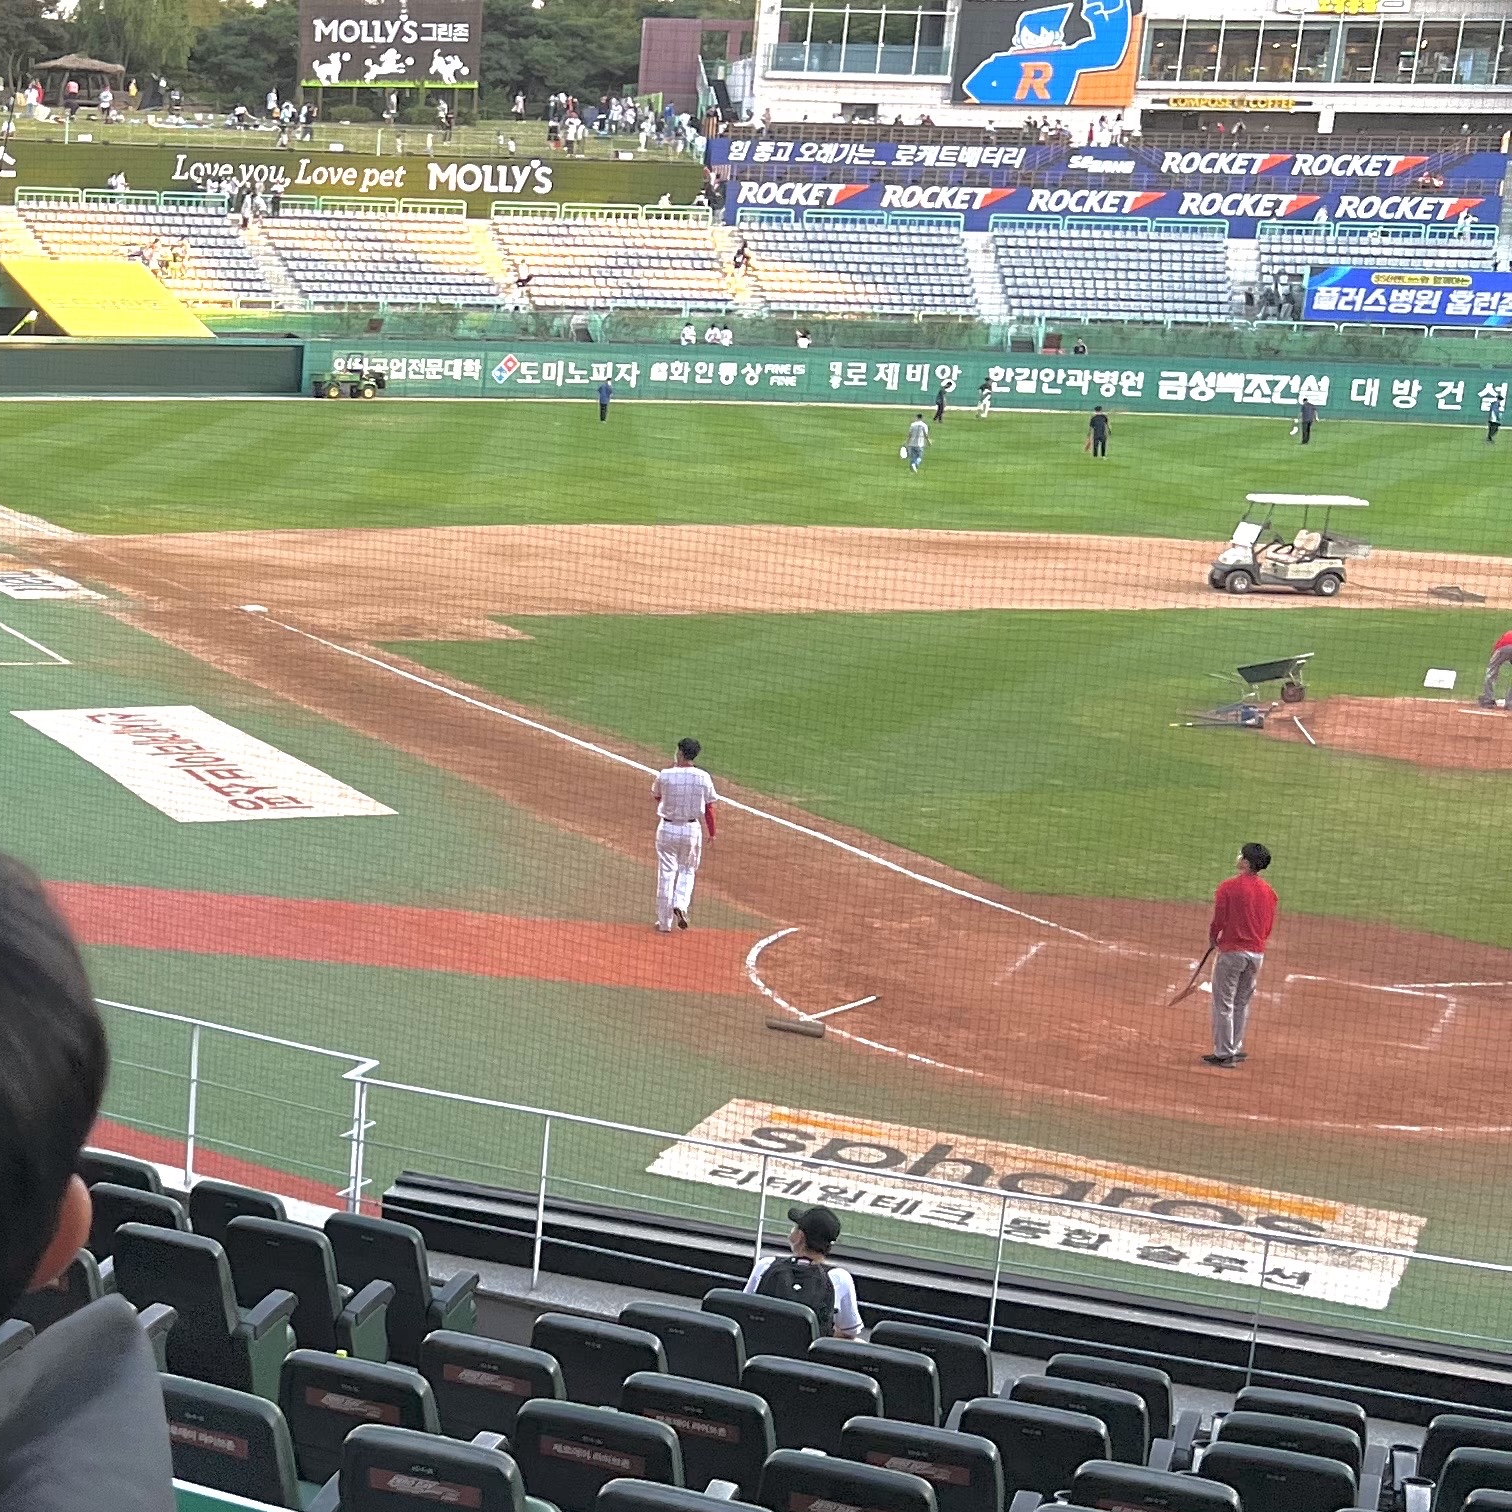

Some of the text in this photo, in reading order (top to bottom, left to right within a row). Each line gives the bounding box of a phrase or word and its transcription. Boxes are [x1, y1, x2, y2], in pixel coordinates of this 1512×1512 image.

[312, 14, 470, 44] MOLLY'S 그린존
[1169, 95, 1296, 111] COMPOSE COFFEE
[728, 140, 751, 161] 힘
[752, 141, 794, 163] 좋고
[891, 144, 1027, 169] 로케트배터리
[1160, 151, 1406, 177] ROCKET ROCKET
[172, 154, 407, 193] Love you, Love pet
[427, 159, 553, 195] MOLLY'S
[738, 181, 1459, 221] ROCKET ROCKET ROCKET ROCKET ROCKET
[1312, 286, 1443, 314] 플러스병원
[516, 360, 641, 389] 도미노피자
[843, 361, 963, 393] 로제비앙
[989, 365, 1145, 398] 한길안과병원
[1158, 370, 1330, 406] 금성백조건설
[708, 1164, 976, 1229] 리테일테크
